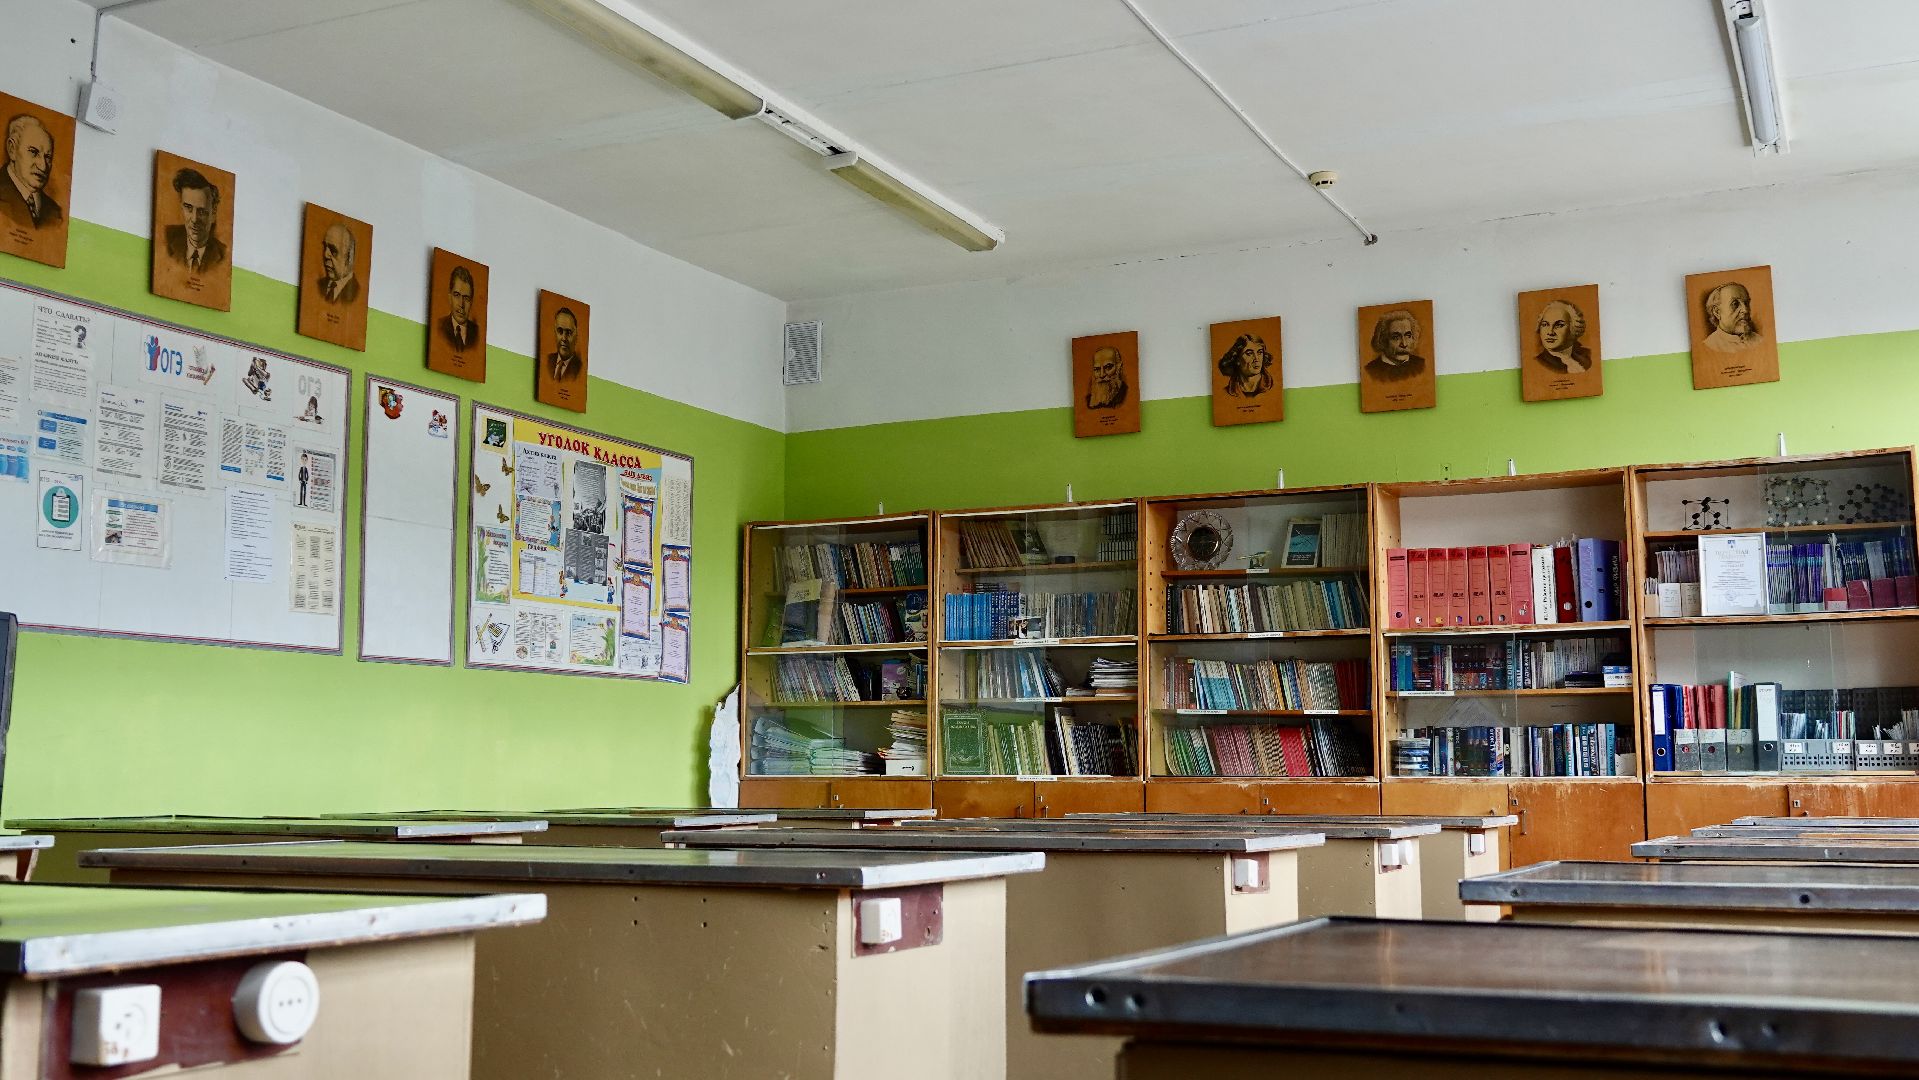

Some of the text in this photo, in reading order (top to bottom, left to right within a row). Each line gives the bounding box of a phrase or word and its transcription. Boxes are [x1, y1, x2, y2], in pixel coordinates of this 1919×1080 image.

[160, 347, 183, 376] ОГЭ
[298, 374, 322, 399] ОГЭ
[538, 431, 642, 469] УГОЛОК КЛАССА
